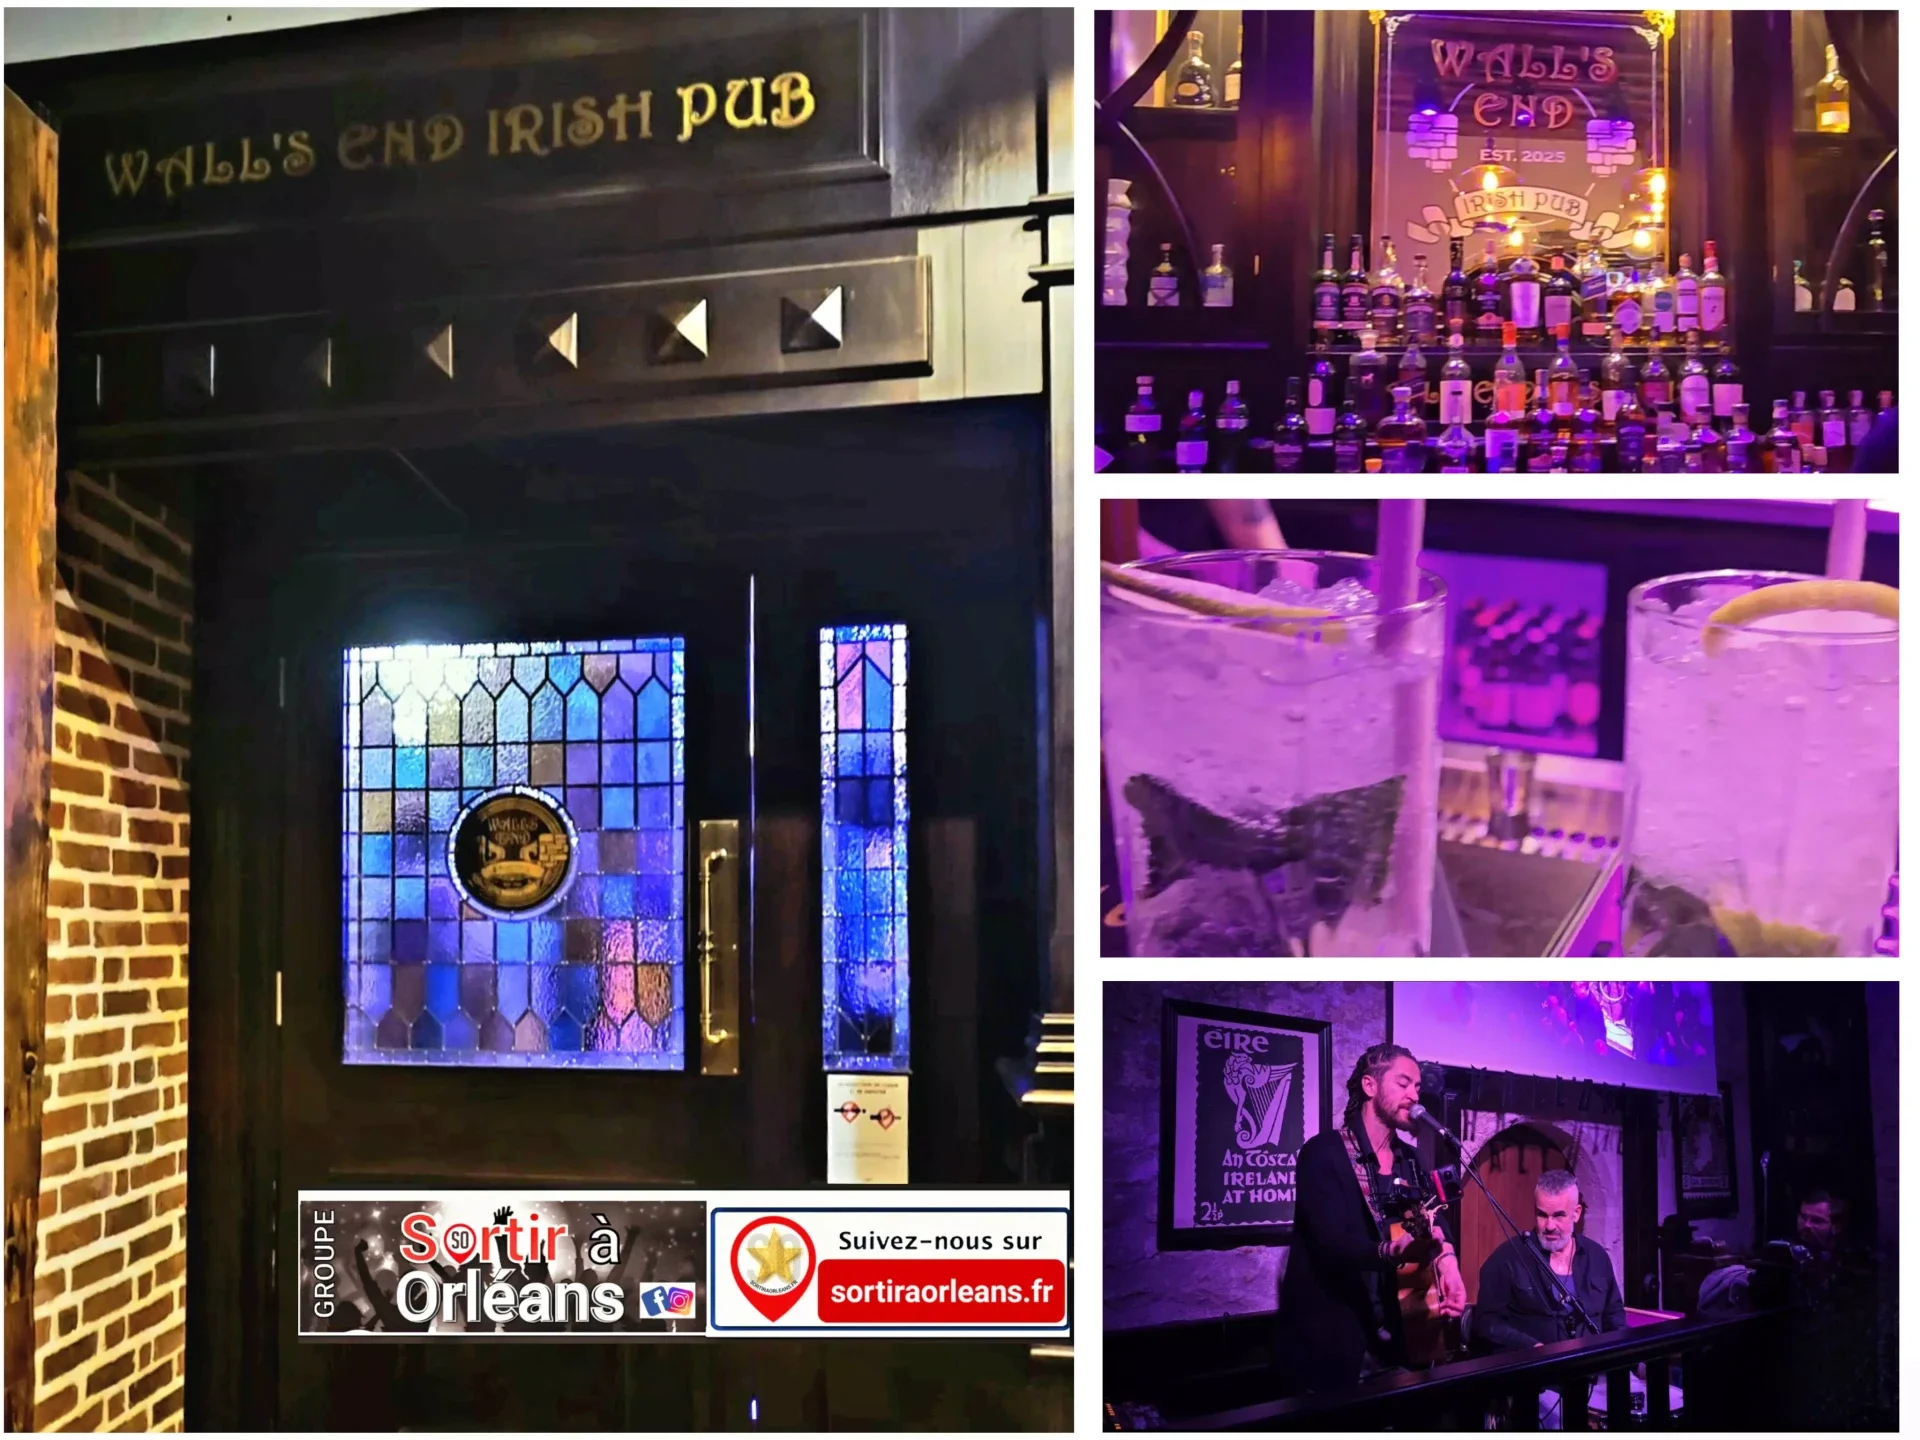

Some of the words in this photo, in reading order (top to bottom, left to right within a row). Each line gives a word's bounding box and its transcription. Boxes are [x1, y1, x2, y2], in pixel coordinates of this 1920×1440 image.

[1430, 38, 1619, 83] WALL'S
[1473, 92, 1574, 129] END
[105, 130, 315, 197] WALL'S
[337, 113, 465, 172] END
[487, 90, 654, 157] IRISH
[675, 70, 817, 142] PUB
[1479, 149, 1518, 162] EST.
[1521, 150, 1566, 163] 2025
[1462, 190, 1525, 214] IRISH
[1534, 192, 1581, 217] PUB
[1222, 1189, 1245, 1204] AT
